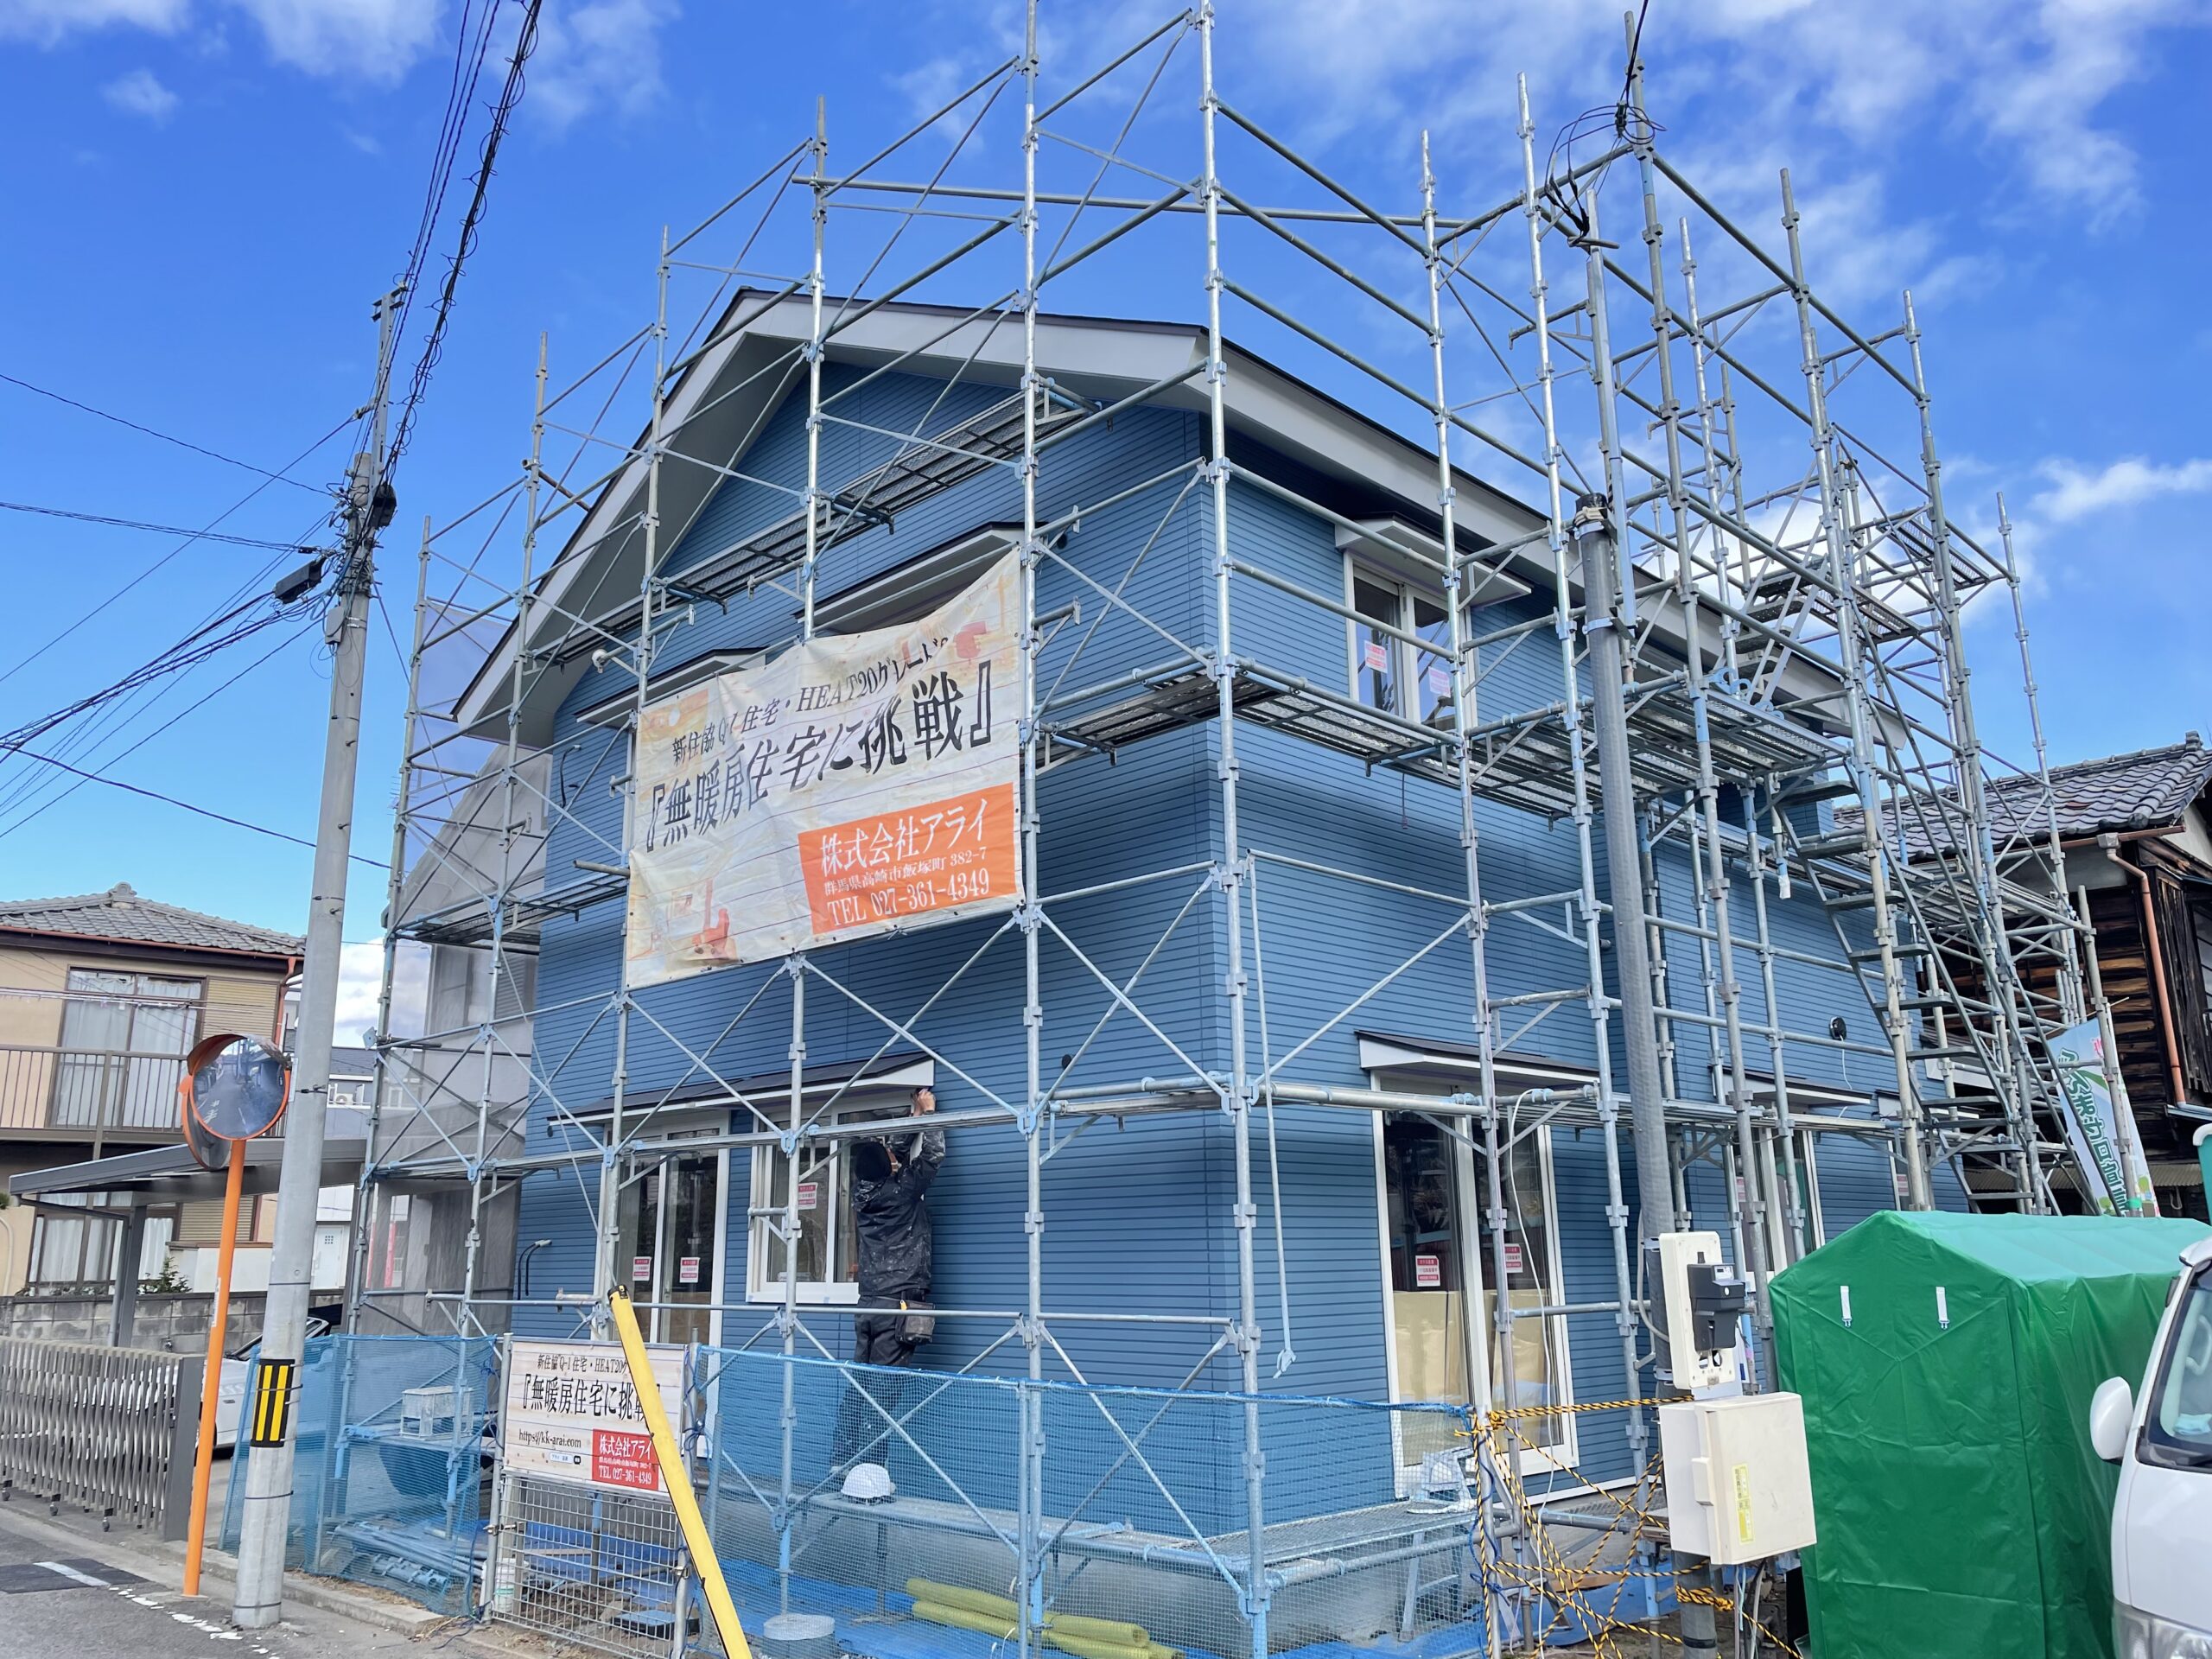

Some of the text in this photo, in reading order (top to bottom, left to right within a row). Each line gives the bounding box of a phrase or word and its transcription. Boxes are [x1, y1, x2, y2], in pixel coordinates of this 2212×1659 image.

[645, 660, 991, 852] 『無暖房住宅に挑戦』
[820, 798, 988, 877] 株式会社アライ
[950, 846, 987, 868] 382-7
[827, 868, 989, 926] TEL 027-361-4349
[519, 1429, 582, 1448] https://kk-arai.com
[599, 1434, 652, 1461] 株式会社アライ
[599, 1465, 652, 1484] TEL 027-361-4349
